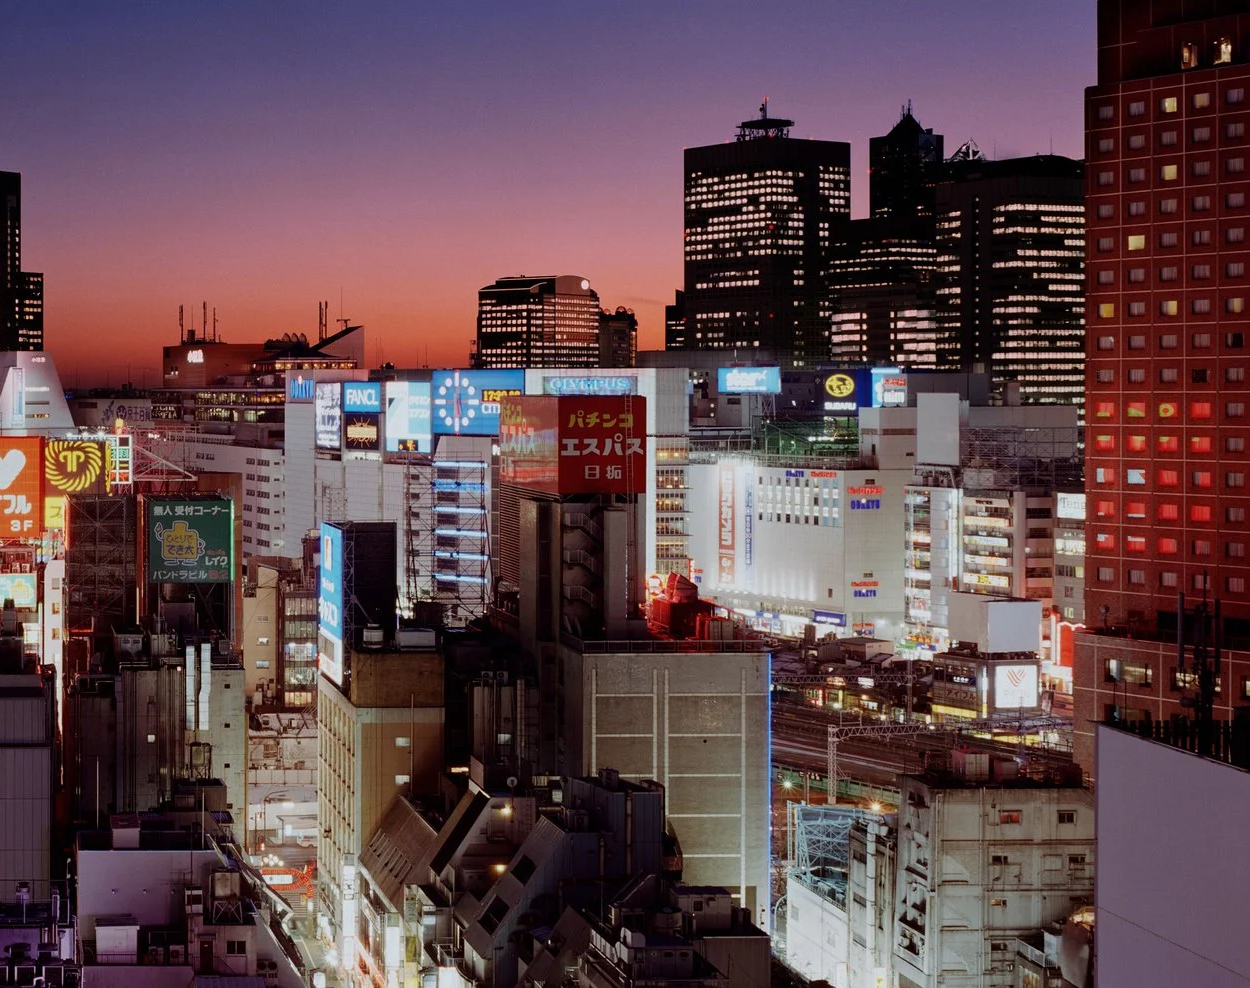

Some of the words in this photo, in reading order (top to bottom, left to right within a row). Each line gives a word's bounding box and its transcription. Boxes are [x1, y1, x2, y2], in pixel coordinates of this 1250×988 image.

[549, 377, 632, 391] OLYMPUS
[345, 388, 379, 405] FANCL
[824, 401, 857, 411] SUBARU
[568, 409, 634, 428] パチンコ
[560, 433, 644, 456] エスパス
[153, 505, 173, 516] 無人
[174, 505, 230, 516] 受付コーナー
[9, 520, 33, 532] 3F
[205, 556, 228, 566] レイク
[946, 690, 976, 701] アイフル
